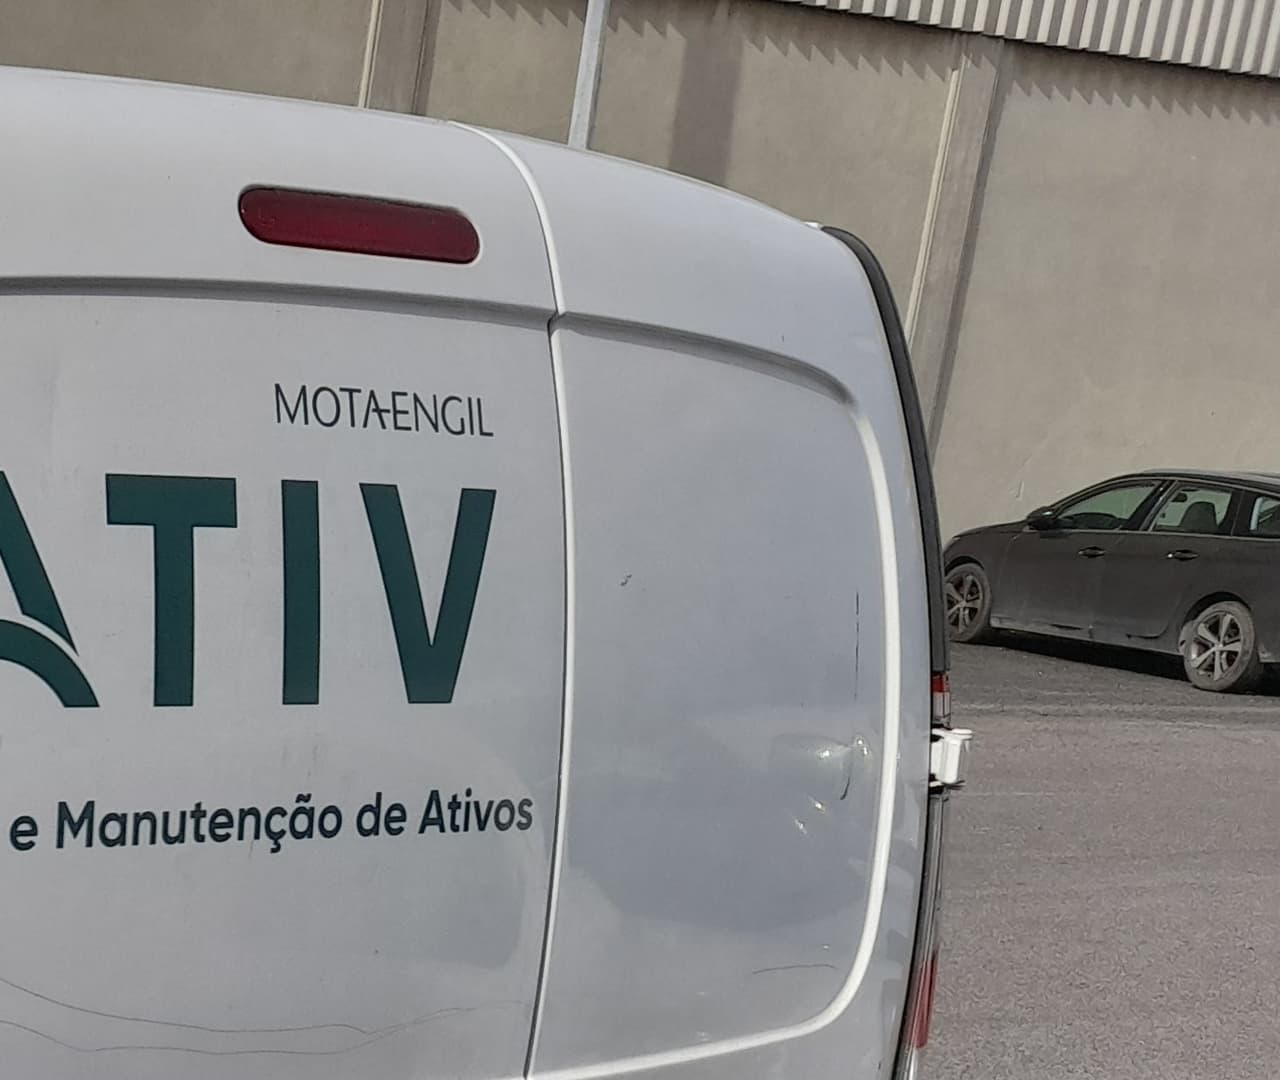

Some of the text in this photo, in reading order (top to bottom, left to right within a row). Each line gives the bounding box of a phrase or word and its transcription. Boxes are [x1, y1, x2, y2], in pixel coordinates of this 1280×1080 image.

[9, 818, 39, 851] e
[54, 796, 345, 854] Manutenção
[355, 792, 408, 839] de
[417, 787, 535, 834] Ativos
